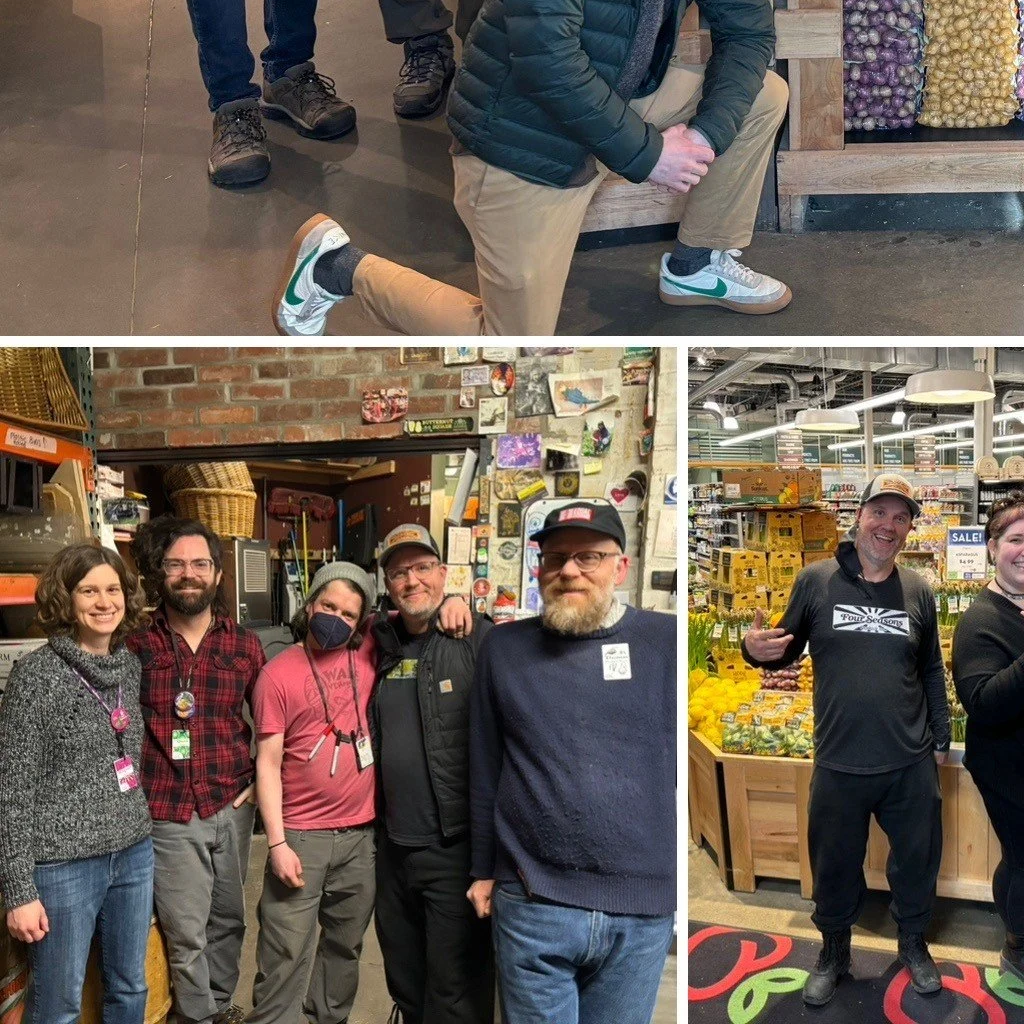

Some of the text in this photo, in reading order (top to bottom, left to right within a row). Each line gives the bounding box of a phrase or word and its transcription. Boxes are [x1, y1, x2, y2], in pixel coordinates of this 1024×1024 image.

[952, 532, 982, 542] SALE!
[840, 612, 904, 627] Four Seasons
